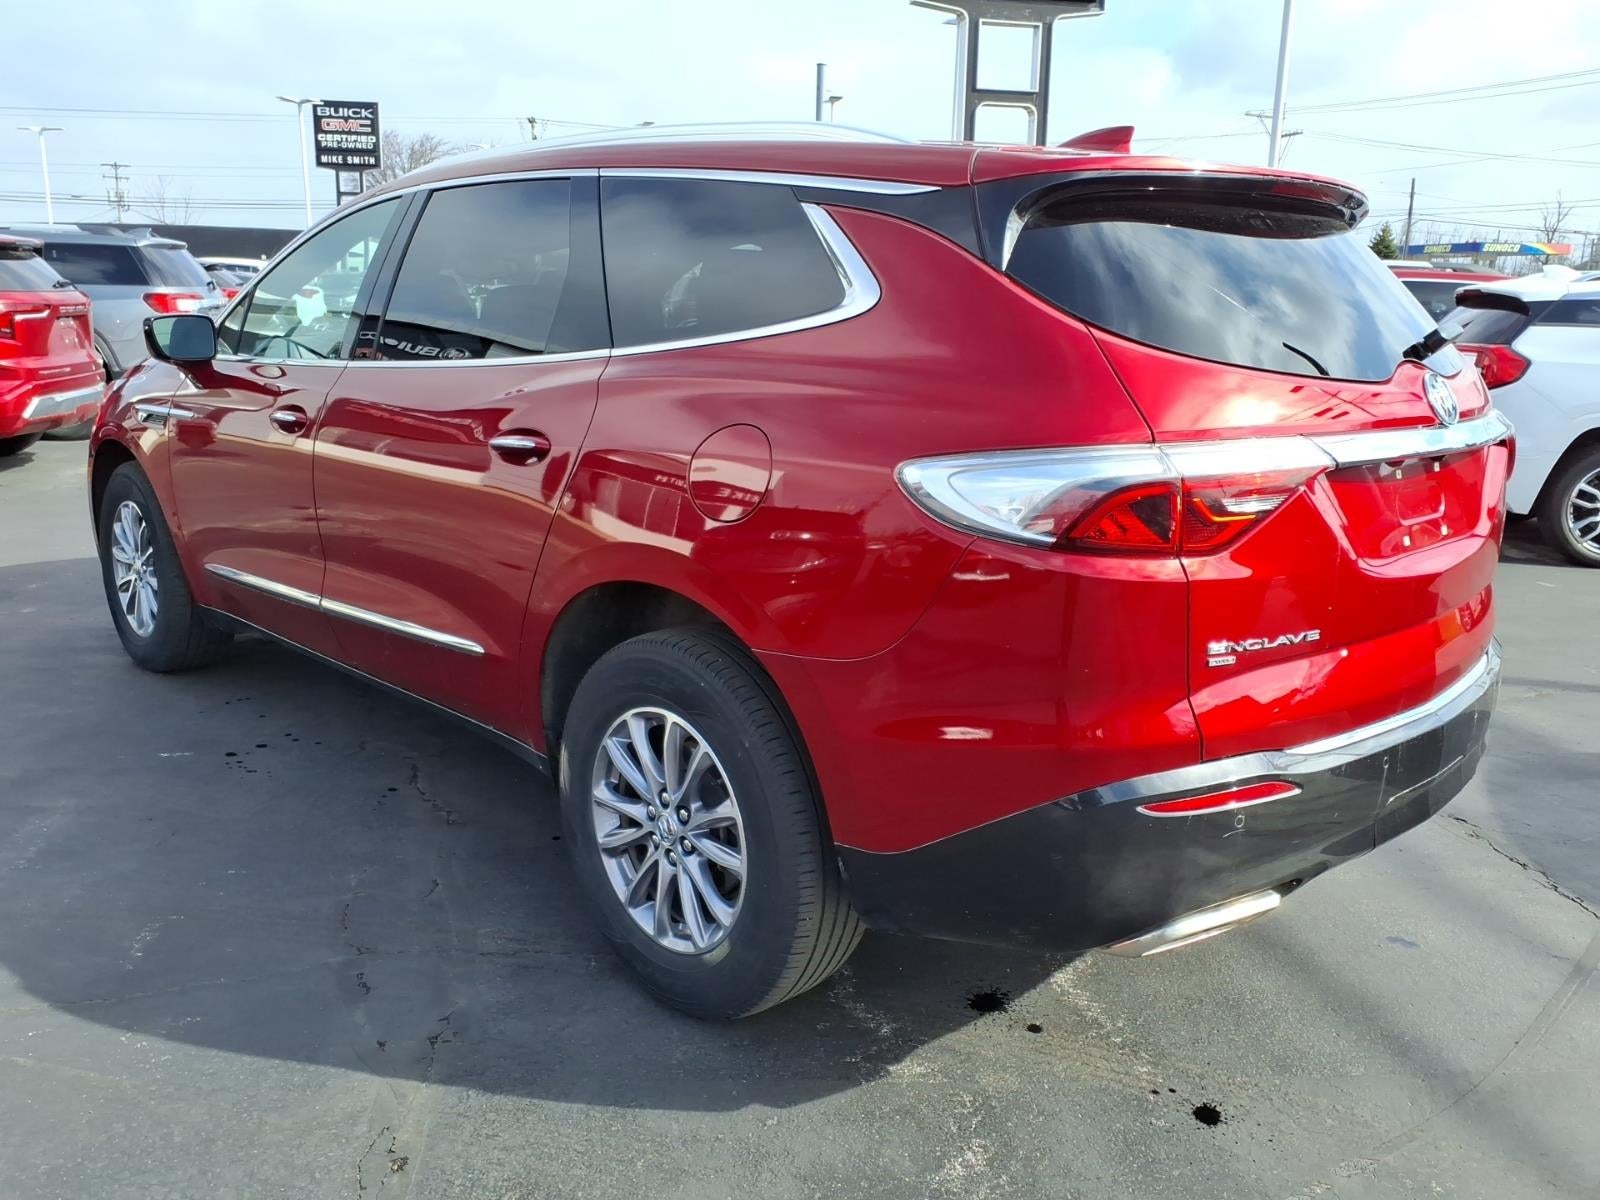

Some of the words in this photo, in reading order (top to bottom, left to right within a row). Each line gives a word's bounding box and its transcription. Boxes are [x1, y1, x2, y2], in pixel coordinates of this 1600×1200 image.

[317, 106, 374, 118] BUICK
[321, 118, 371, 132] GMC
[317, 133, 376, 143] CERTIFIED
[321, 141, 374, 149] PRE-OWNED
[321, 154, 343, 164] MIKE
[347, 155, 375, 165] SMITH
[1483, 243, 1521, 253] SUNOCO
[1208, 629, 1321, 655] ENCLAVE
